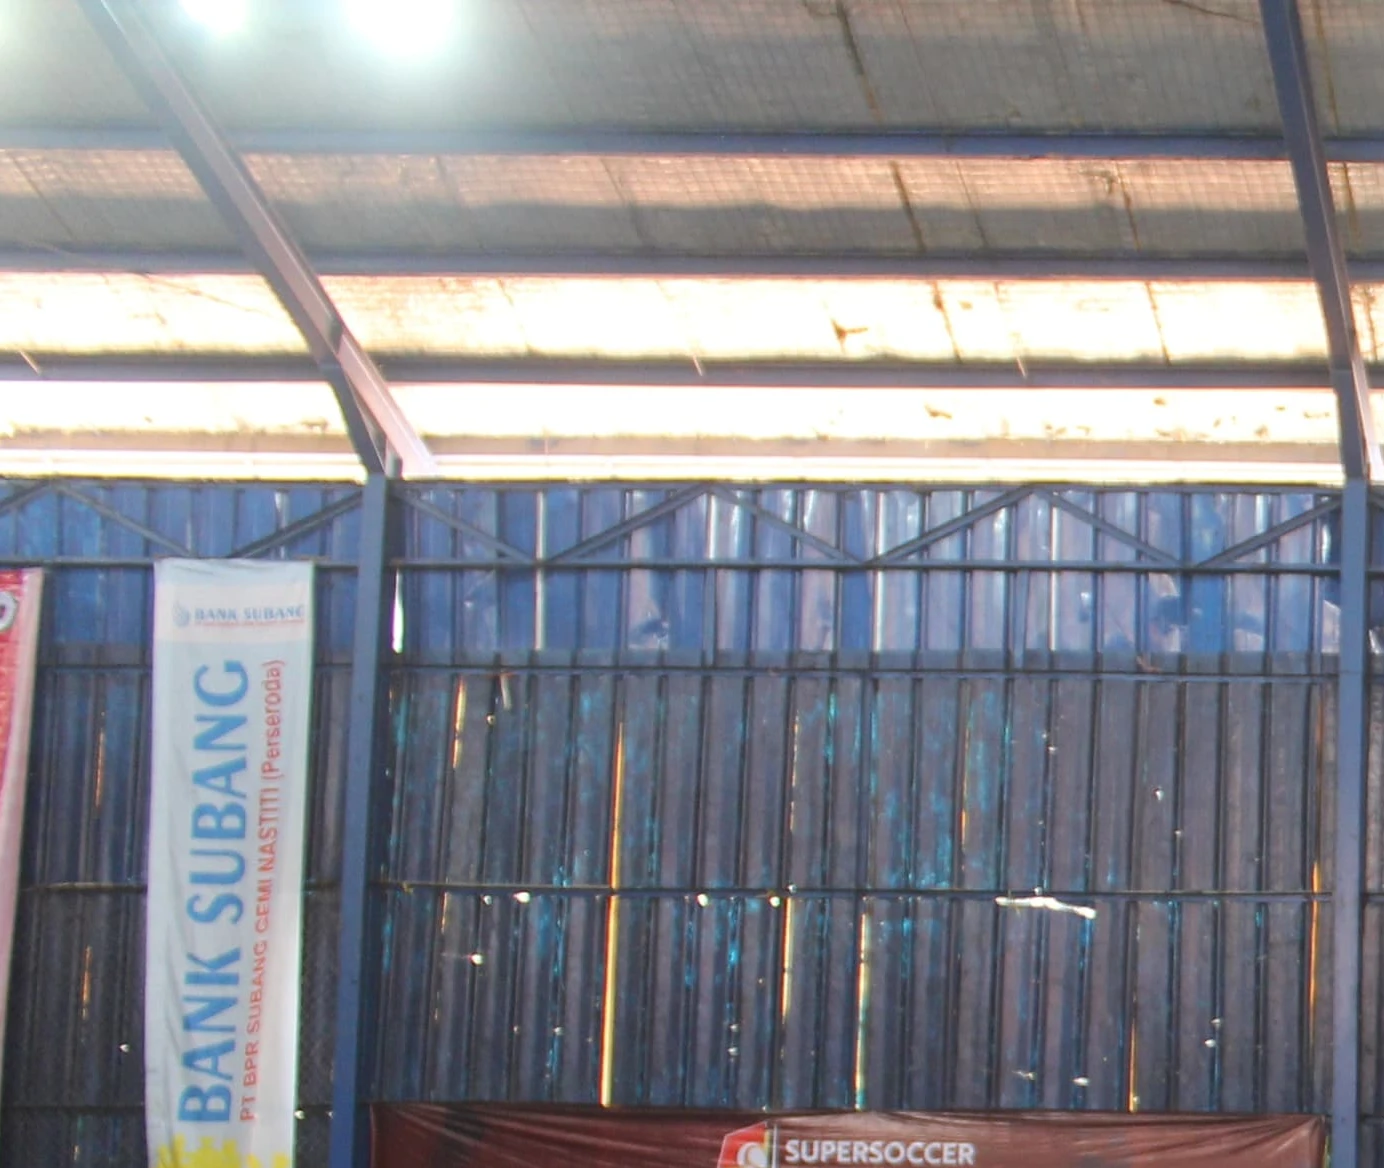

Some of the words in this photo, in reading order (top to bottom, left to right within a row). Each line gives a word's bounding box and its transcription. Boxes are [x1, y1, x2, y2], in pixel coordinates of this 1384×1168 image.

[194, 608, 237, 621] BANK
[261, 659, 286, 781] (Perseroda)
[186, 659, 249, 925] SUBANG
[257, 787, 279, 872] NASTITI
[246, 940, 268, 1034] SUBANG
[178, 947, 241, 1123] BANK
[243, 1041, 260, 1087] BPR
[239, 1095, 255, 1121] PT
[784, 1138, 976, 1167] SUPERSOCCER
